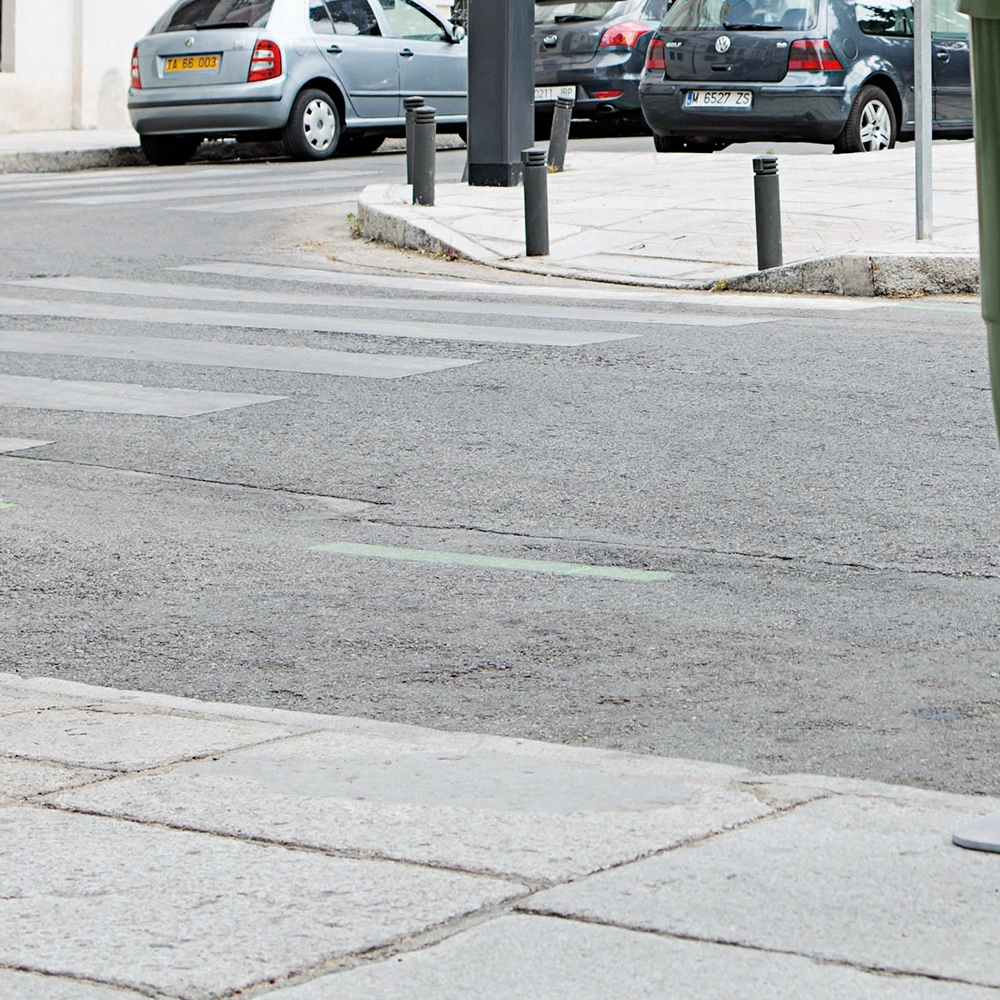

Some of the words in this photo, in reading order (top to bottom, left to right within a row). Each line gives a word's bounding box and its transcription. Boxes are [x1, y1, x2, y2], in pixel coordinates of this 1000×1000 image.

[167, 59, 178, 70] TA
[182, 58, 194, 68] 66
[198, 57, 217, 67] 003
[703, 92, 732, 104] 6527
[736, 92, 750, 104] ZS
